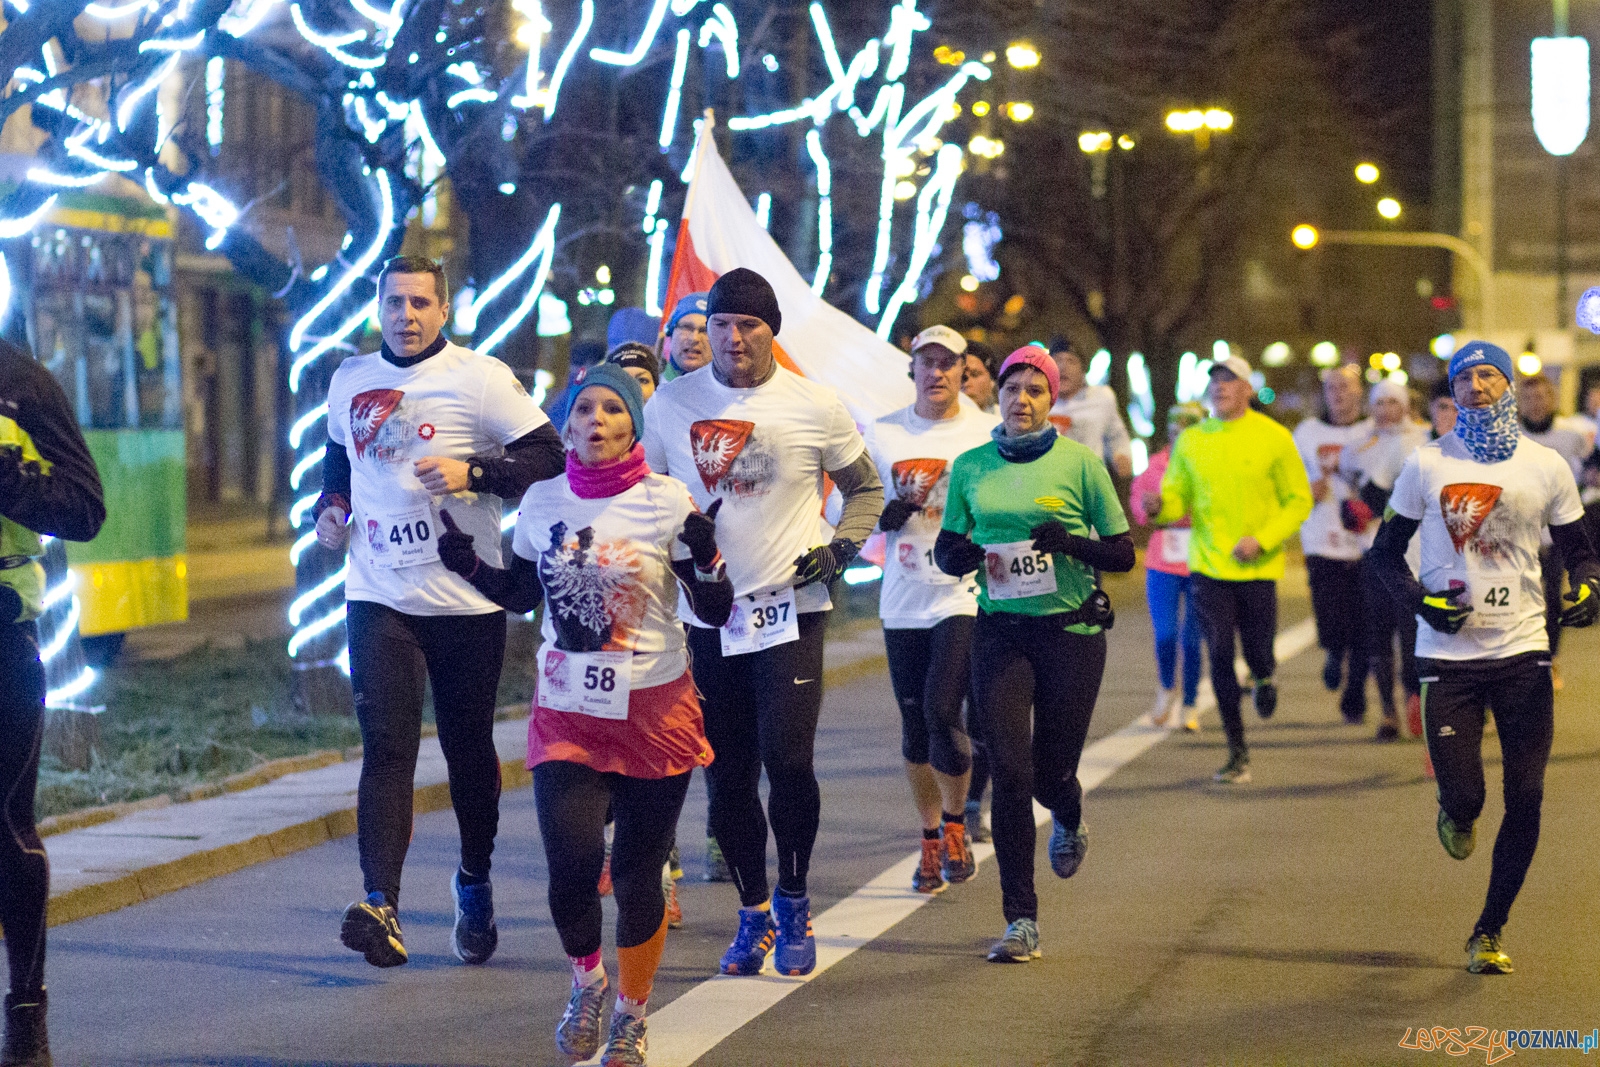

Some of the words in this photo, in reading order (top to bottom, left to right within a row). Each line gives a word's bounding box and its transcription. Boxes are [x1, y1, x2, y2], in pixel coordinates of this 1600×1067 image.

[389, 519, 430, 546] 410
[1010, 553, 1049, 577] 485
[1484, 586, 1510, 607] 42
[751, 601, 791, 629] 397
[583, 665, 616, 692] 58
